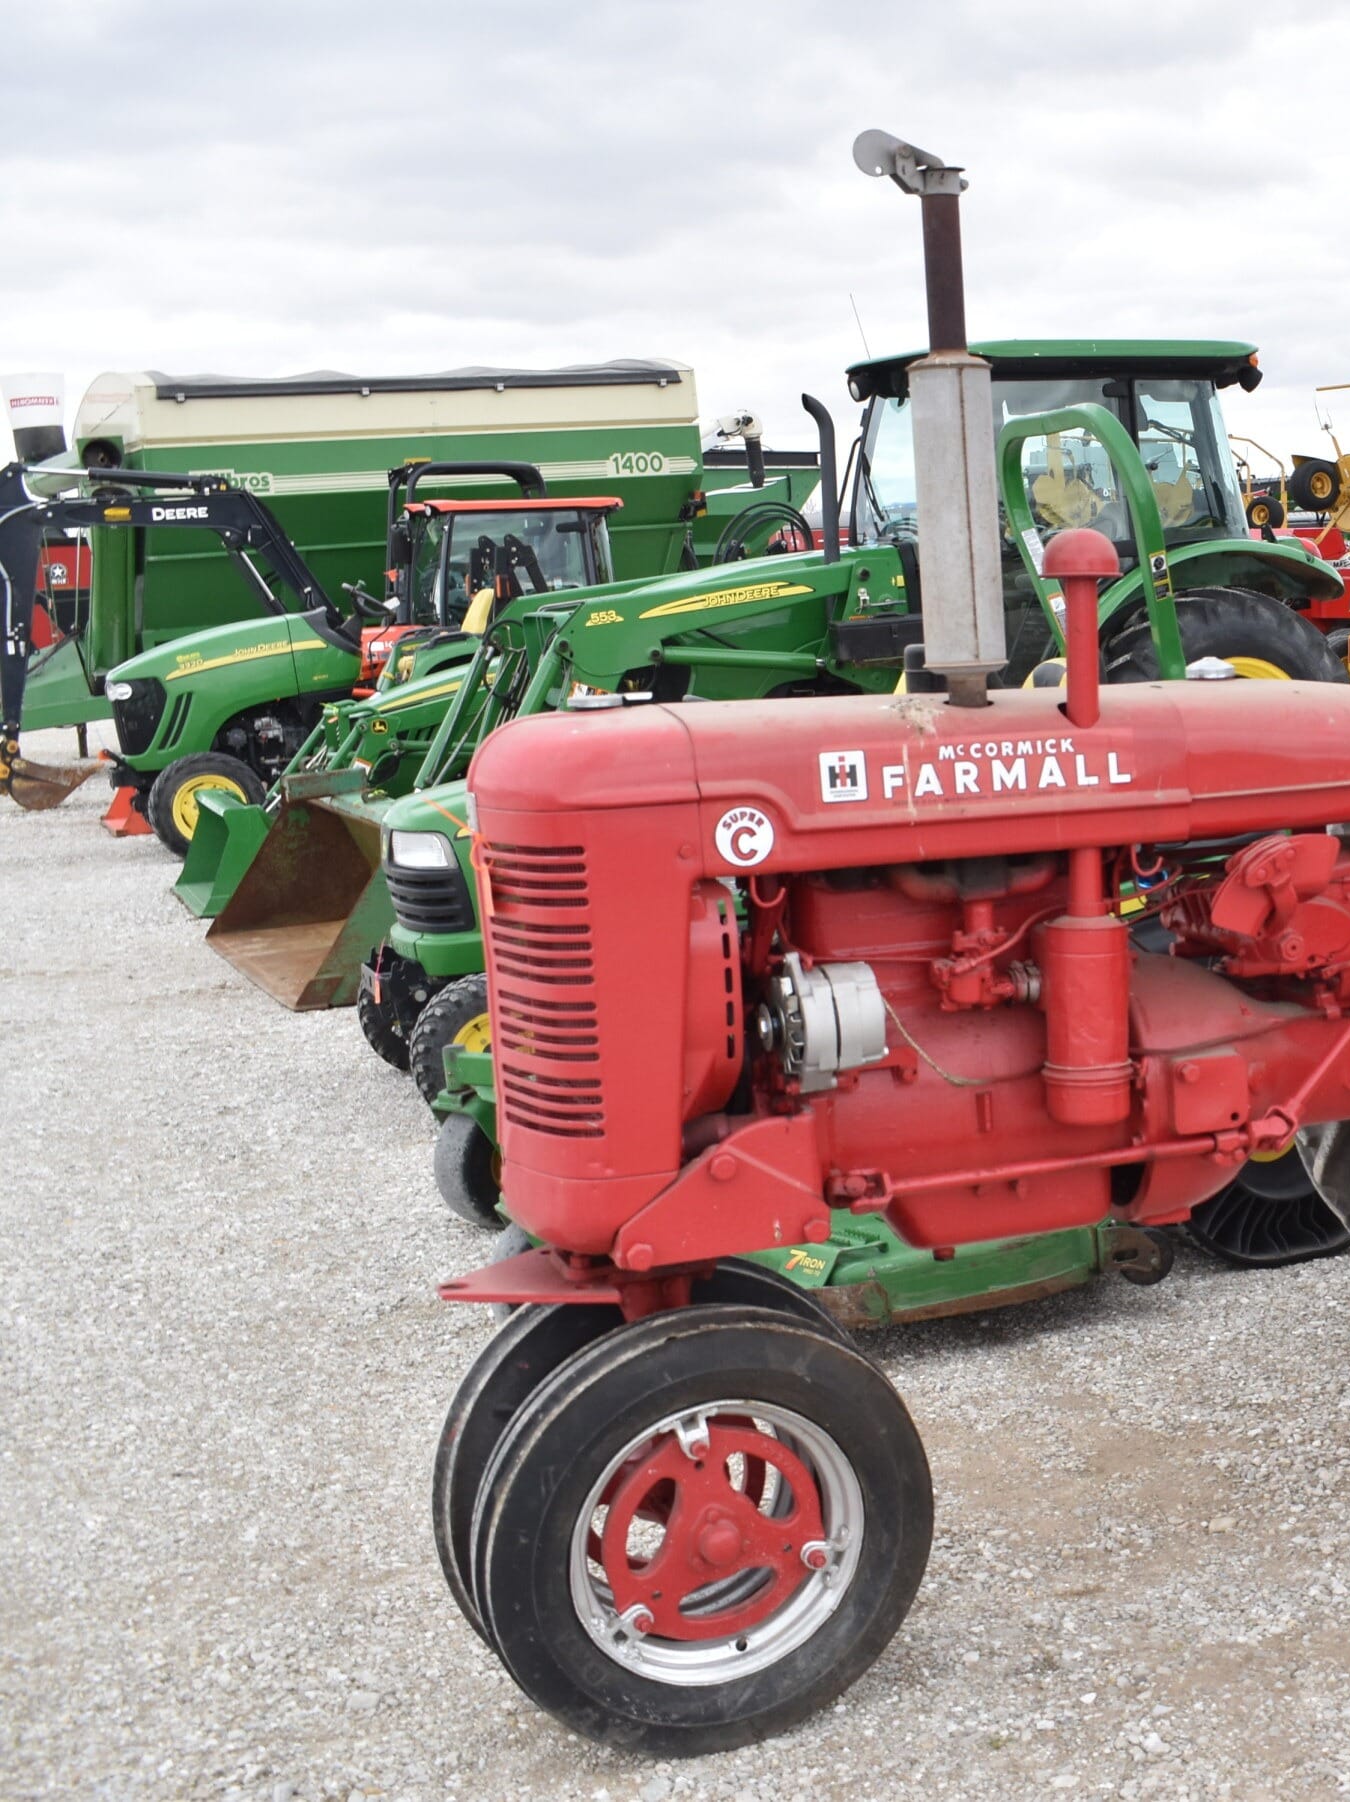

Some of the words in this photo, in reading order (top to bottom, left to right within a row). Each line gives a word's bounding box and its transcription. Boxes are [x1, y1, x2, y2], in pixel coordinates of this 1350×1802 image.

[612, 455, 663, 475] 1400
[152, 506, 209, 521] DEERE
[704, 594, 737, 608] JOHN
[736, 586, 780, 602] DEERE
[590, 610, 617, 625] 553
[881, 752, 1133, 799] FARMALL
[722, 811, 765, 831] SUPER
[730, 826, 758, 861] C
[785, 1249, 808, 1271] 7
[799, 1256, 826, 1270] IRON
